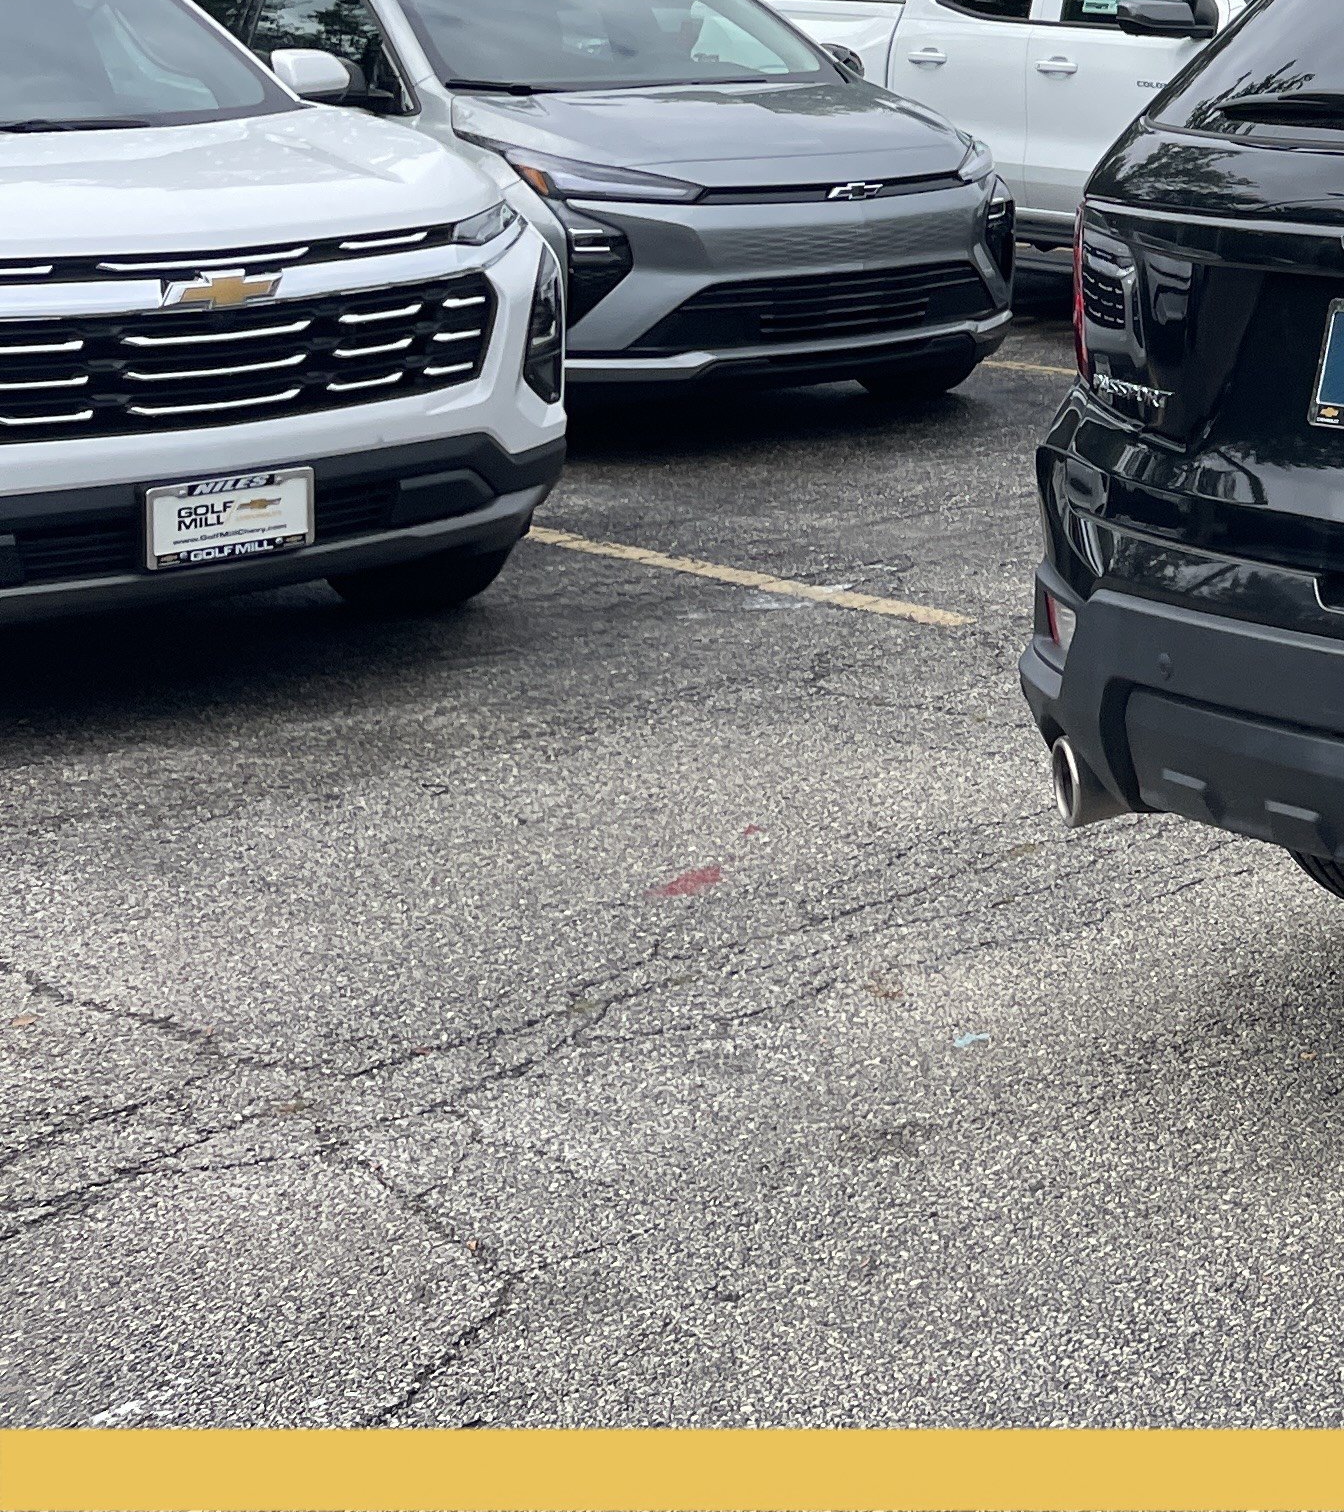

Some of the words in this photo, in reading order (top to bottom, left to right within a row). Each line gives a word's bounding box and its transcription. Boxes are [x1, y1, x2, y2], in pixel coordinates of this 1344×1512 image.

[193, 474, 270, 495] NILES
[177, 500, 234, 519] GOLF
[177, 515, 225, 531] MILL
[190, 545, 234, 561] GOLF
[235, 540, 274, 555] MILL
